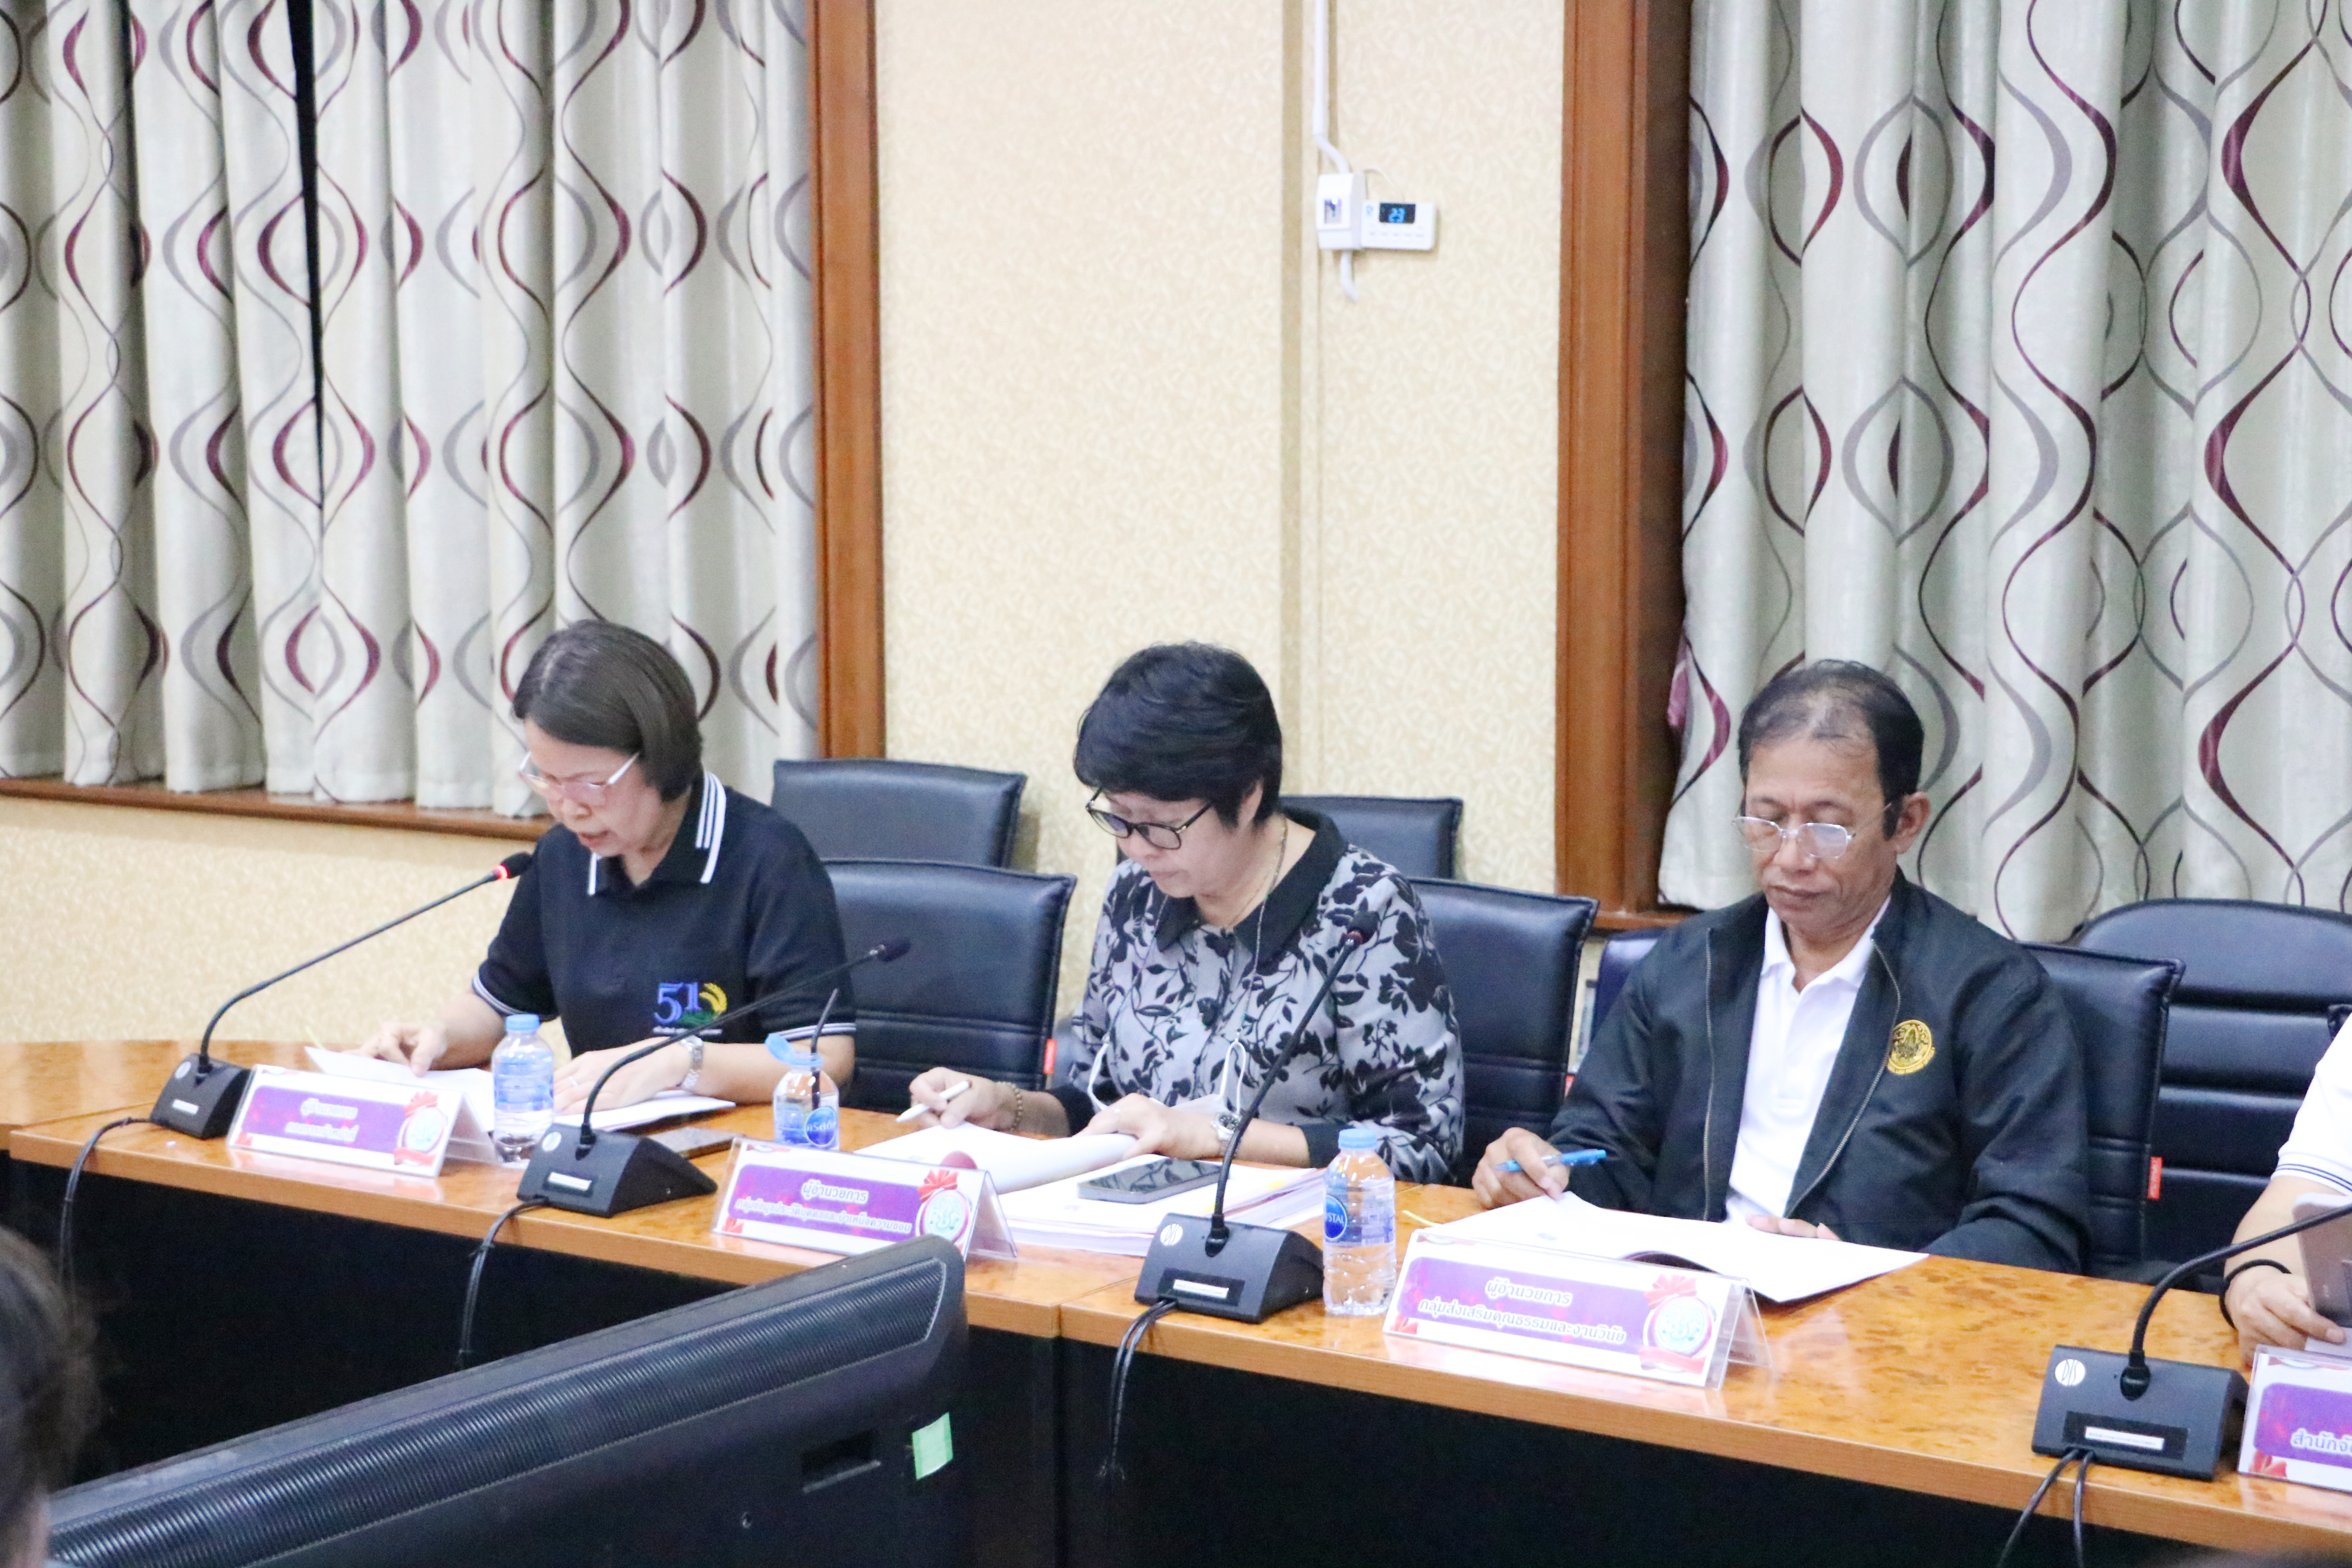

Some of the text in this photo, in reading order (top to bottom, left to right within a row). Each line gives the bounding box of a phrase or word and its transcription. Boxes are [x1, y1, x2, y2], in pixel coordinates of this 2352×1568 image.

[802, 1180, 868, 1202] ผู้อำนวยการ
[1487, 1278, 1571, 1305] ผู้อำนวยการ
[1419, 1298, 1625, 1342] กลุ่มส่งเสริมคุณธรรมและงานวินัย
[2293, 1430, 2352, 1453] สำนักจั
